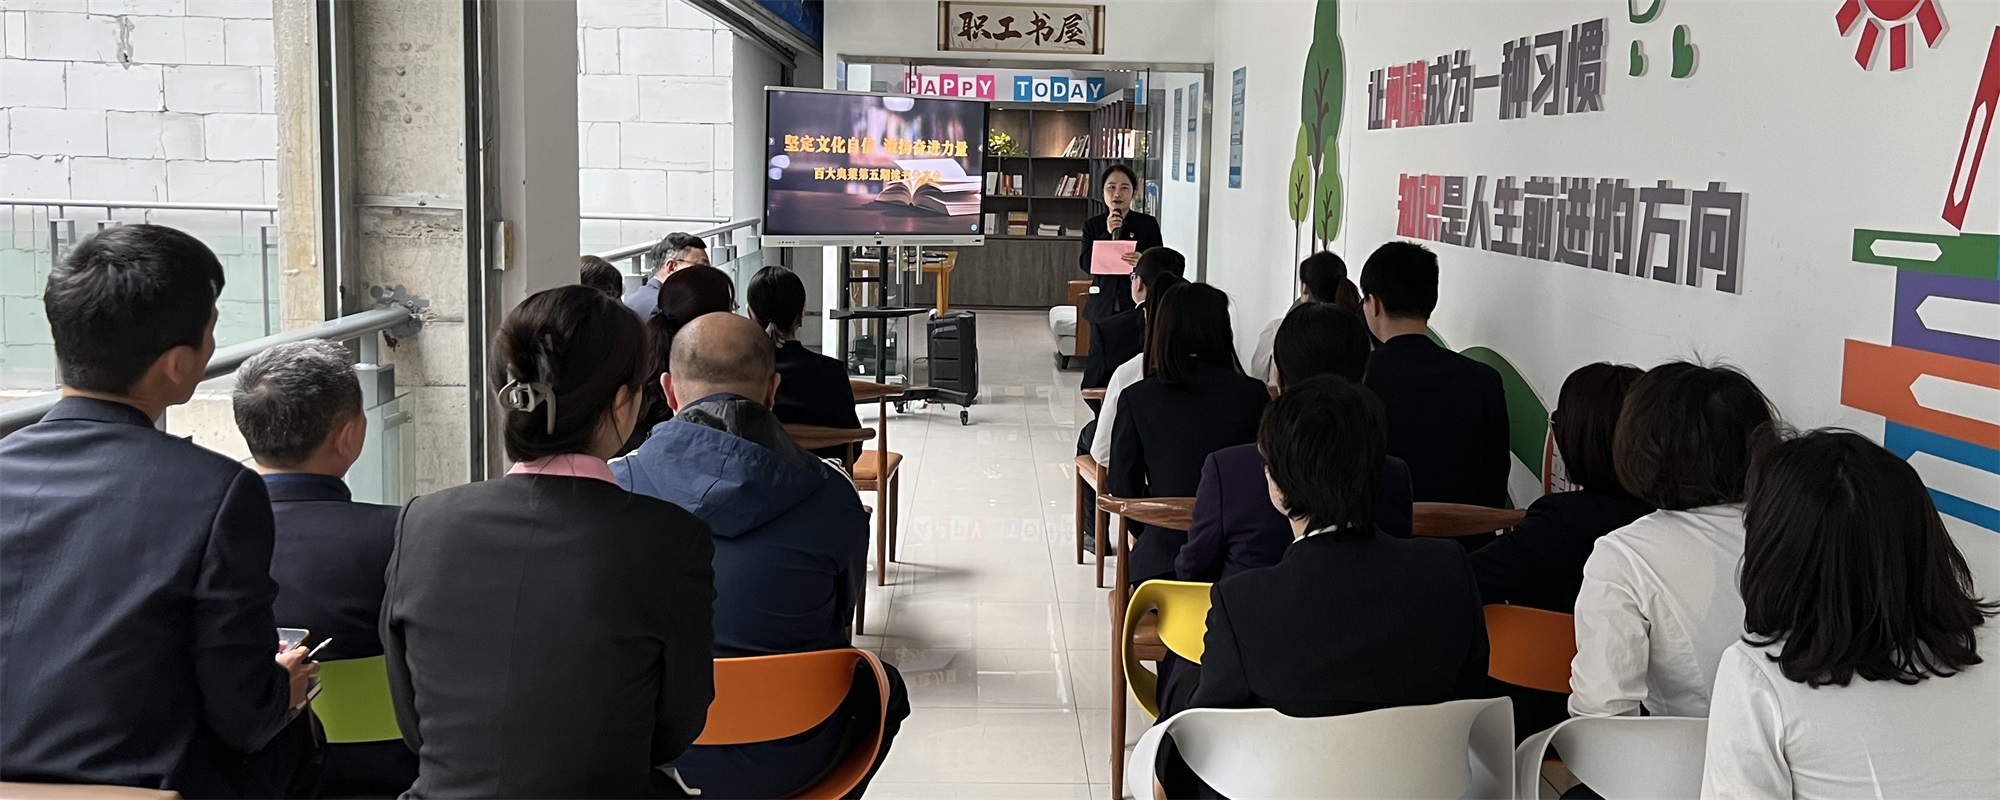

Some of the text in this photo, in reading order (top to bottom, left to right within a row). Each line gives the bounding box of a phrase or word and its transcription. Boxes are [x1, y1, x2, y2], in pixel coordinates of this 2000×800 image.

[957, 11, 1086, 46] 职工书屋
[1017, 82, 1103, 98] TODAY
[1368, 18, 1607, 130] 让阅读成为一种习惯
[784, 134, 876, 154] 坚定文化自信
[1396, 174, 1748, 295] 知识是人生前进的方向
